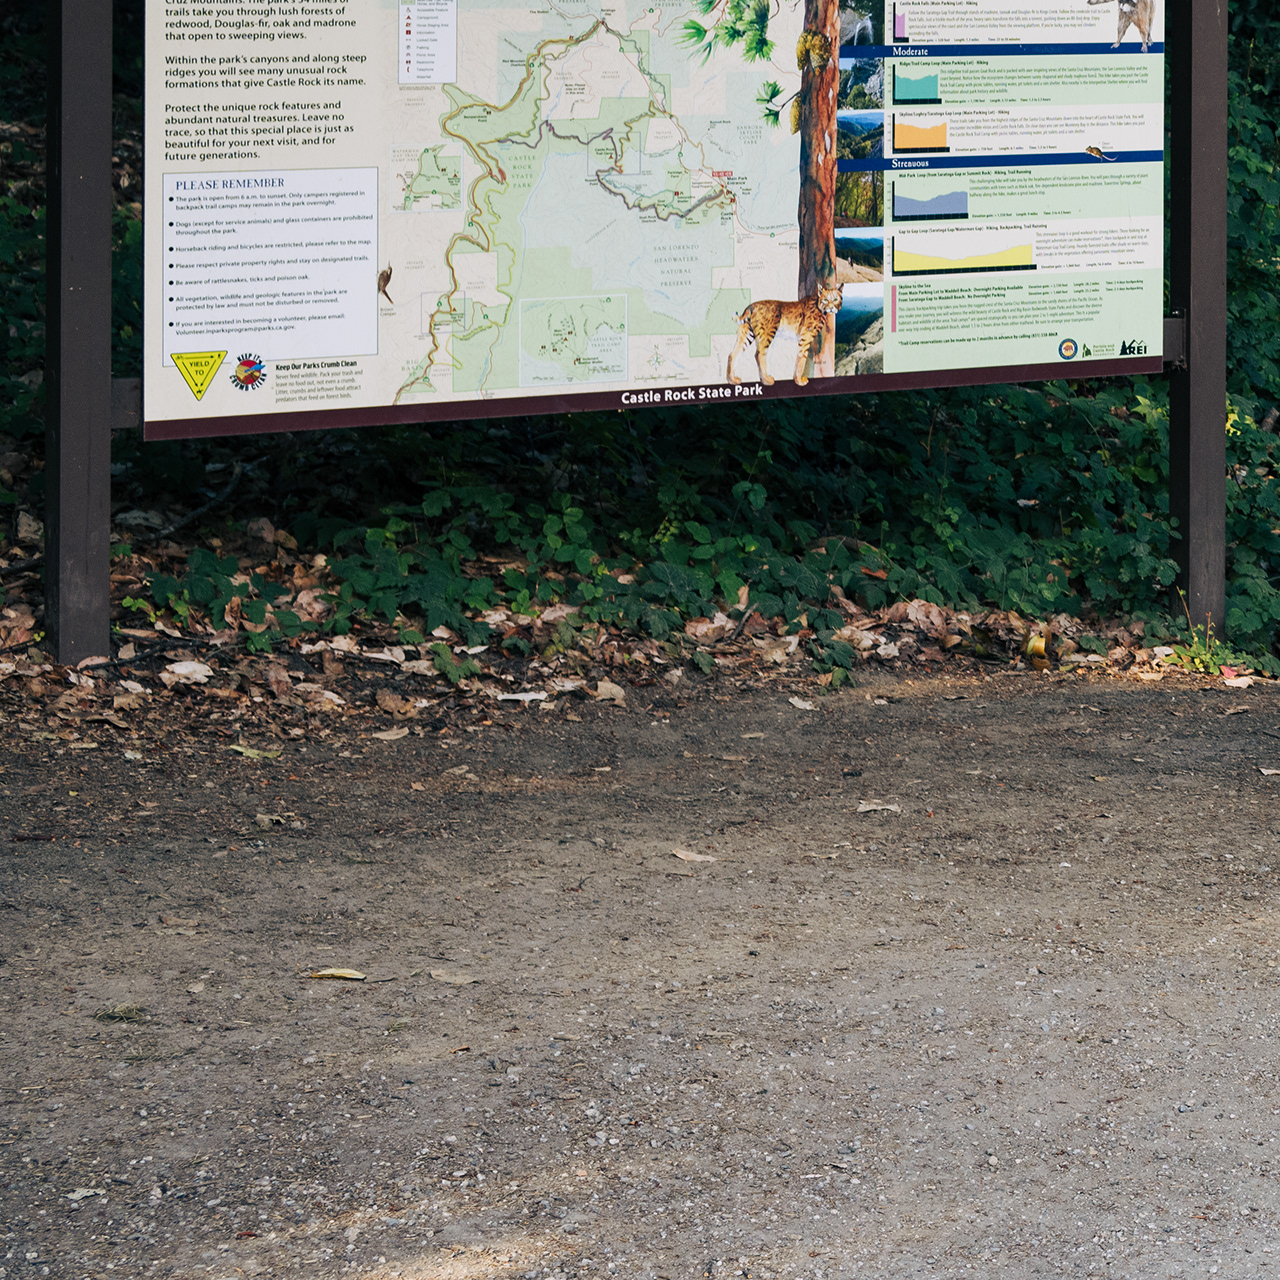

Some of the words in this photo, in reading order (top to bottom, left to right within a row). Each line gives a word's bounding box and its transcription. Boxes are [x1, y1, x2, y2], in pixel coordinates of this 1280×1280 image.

[891, 46, 929, 57] Moderate
[891, 158, 930, 169] Strenuous
[176, 179, 219, 191] PLEASE
[222, 177, 285, 189] REMEMBER
[1128, 345, 1147, 355] REI
[189, 360, 210, 368] YIELD
[275, 363, 290, 371] Keep
[320, 361, 340, 369] Crumb
[340, 360, 358, 368] Clean
[621, 390, 662, 405] Castle
[664, 387, 696, 402] Rock
[698, 387, 732, 399] State
[734, 382, 763, 397] Park
